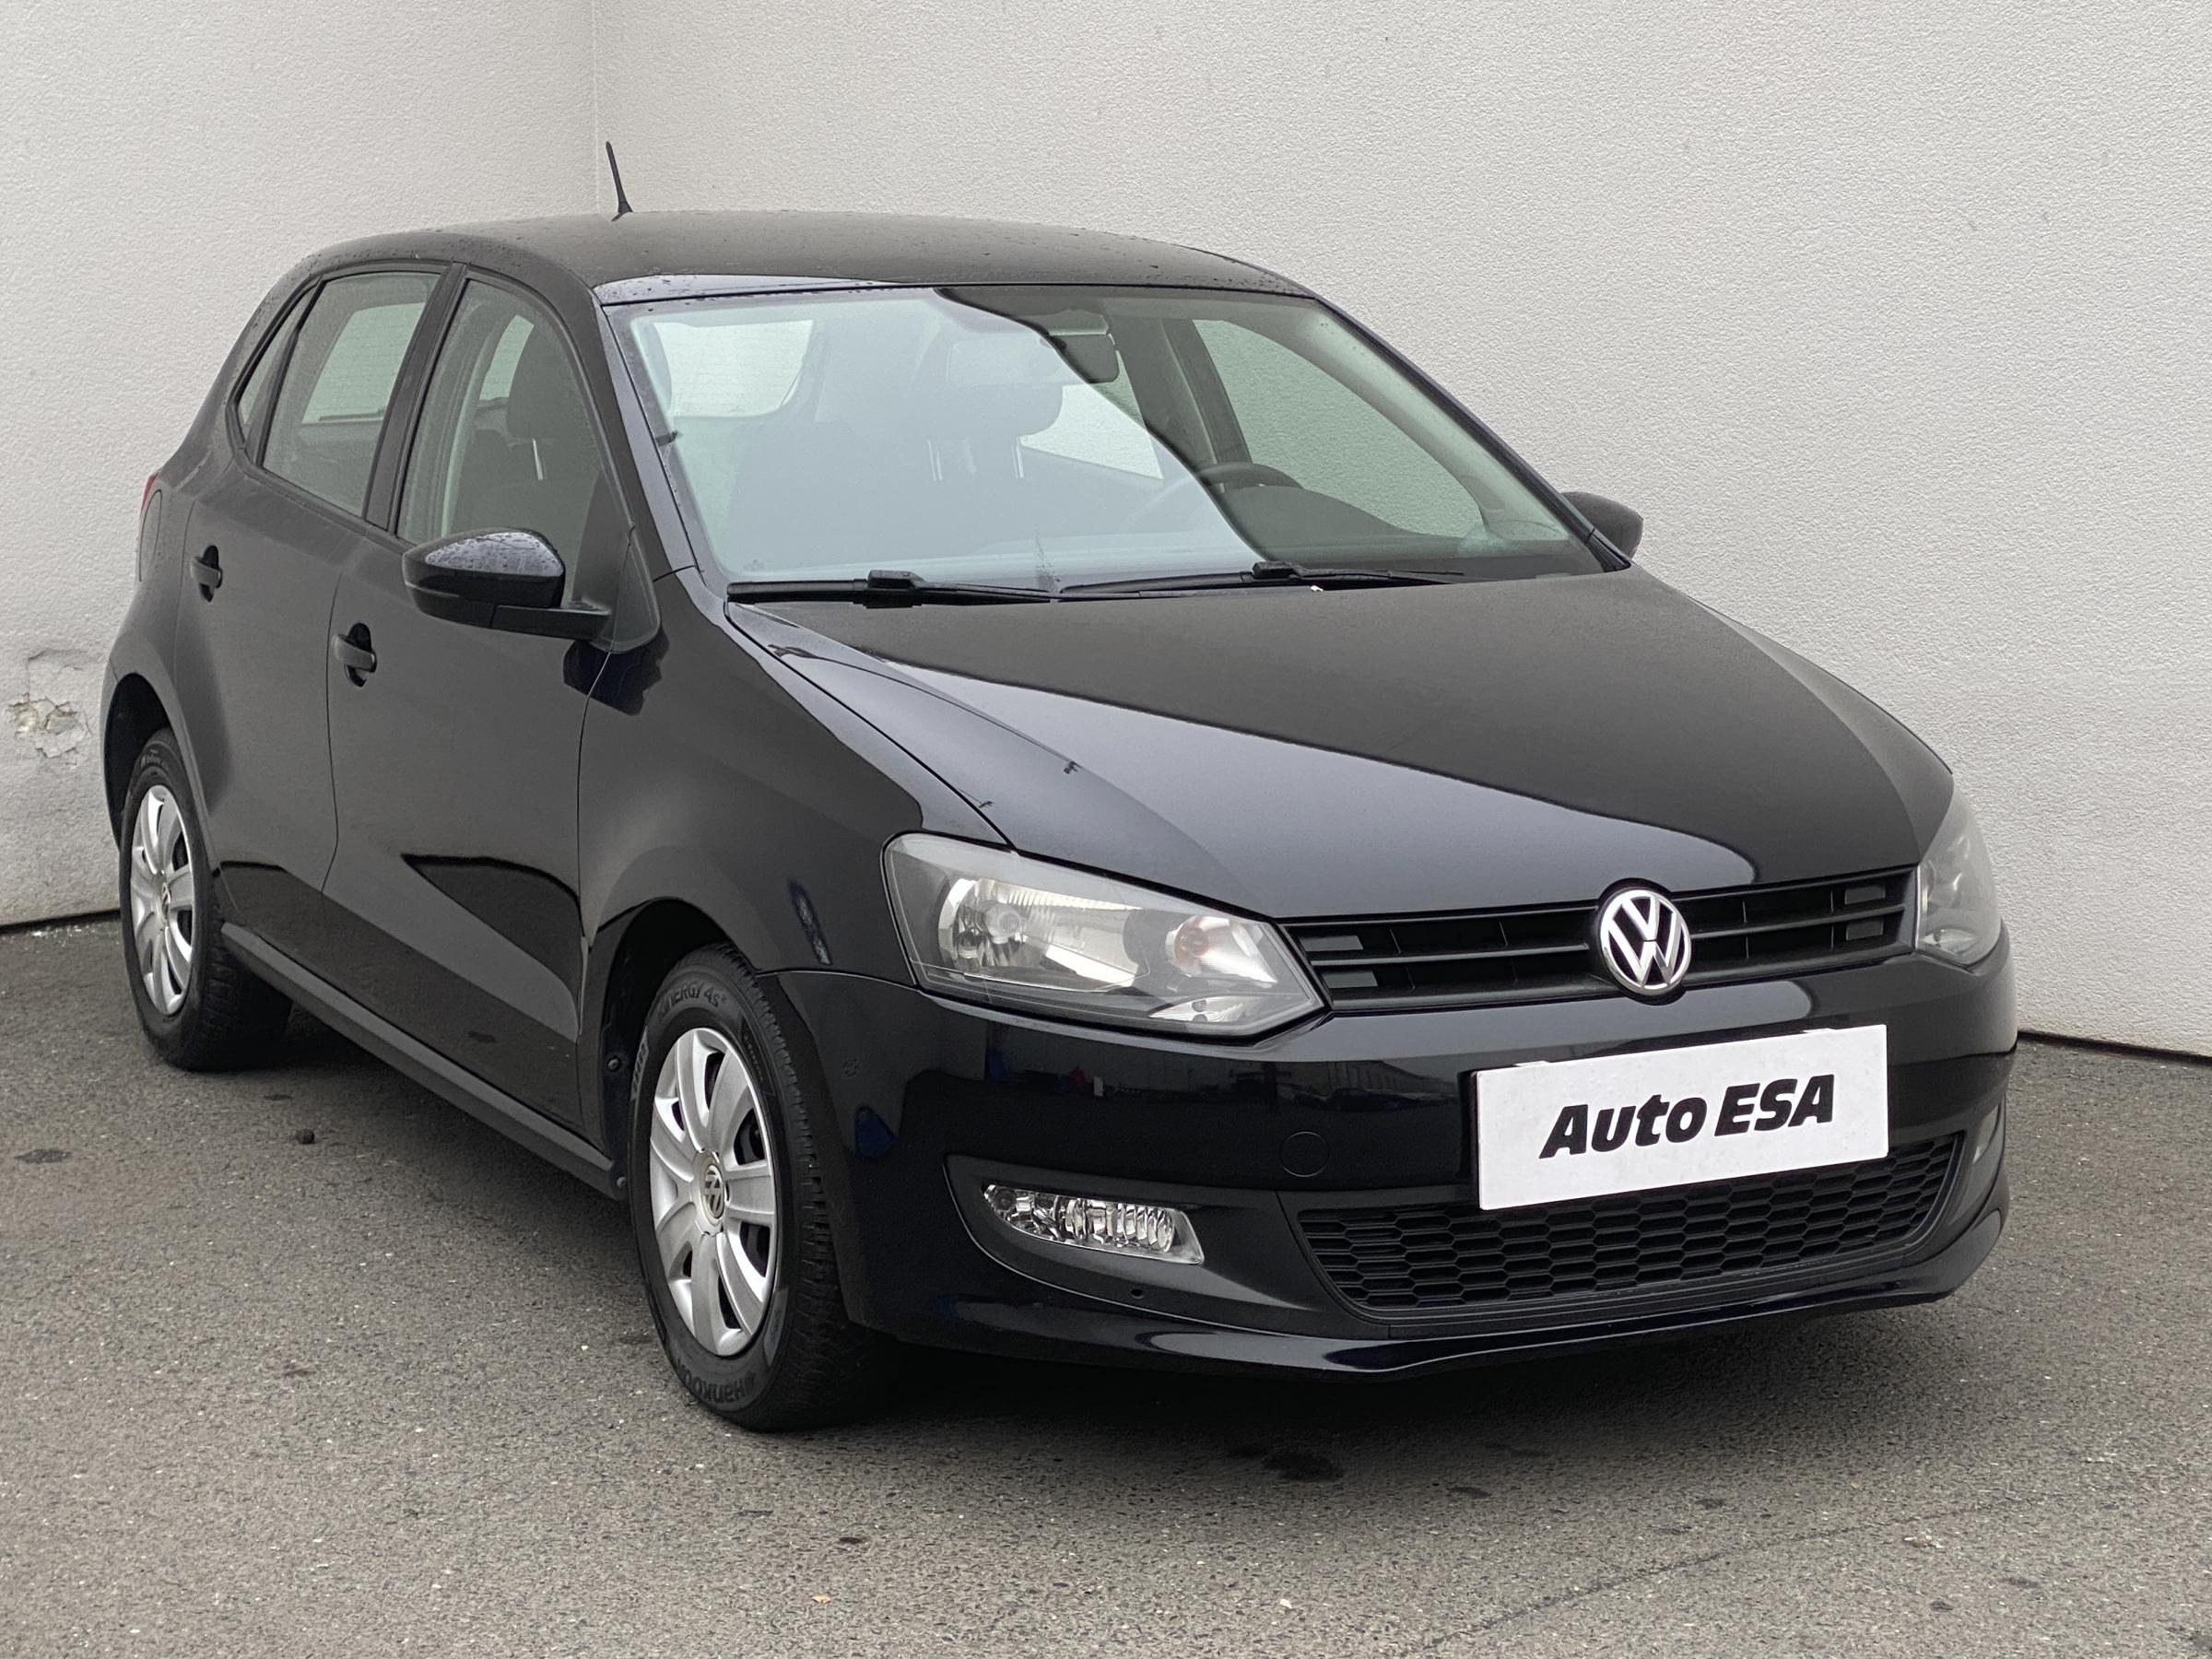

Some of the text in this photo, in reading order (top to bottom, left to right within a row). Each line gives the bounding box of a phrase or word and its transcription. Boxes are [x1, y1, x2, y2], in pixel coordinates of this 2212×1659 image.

[1604, 891, 1688, 991] VW
[1539, 1075, 1835, 1159] Auto ESA
